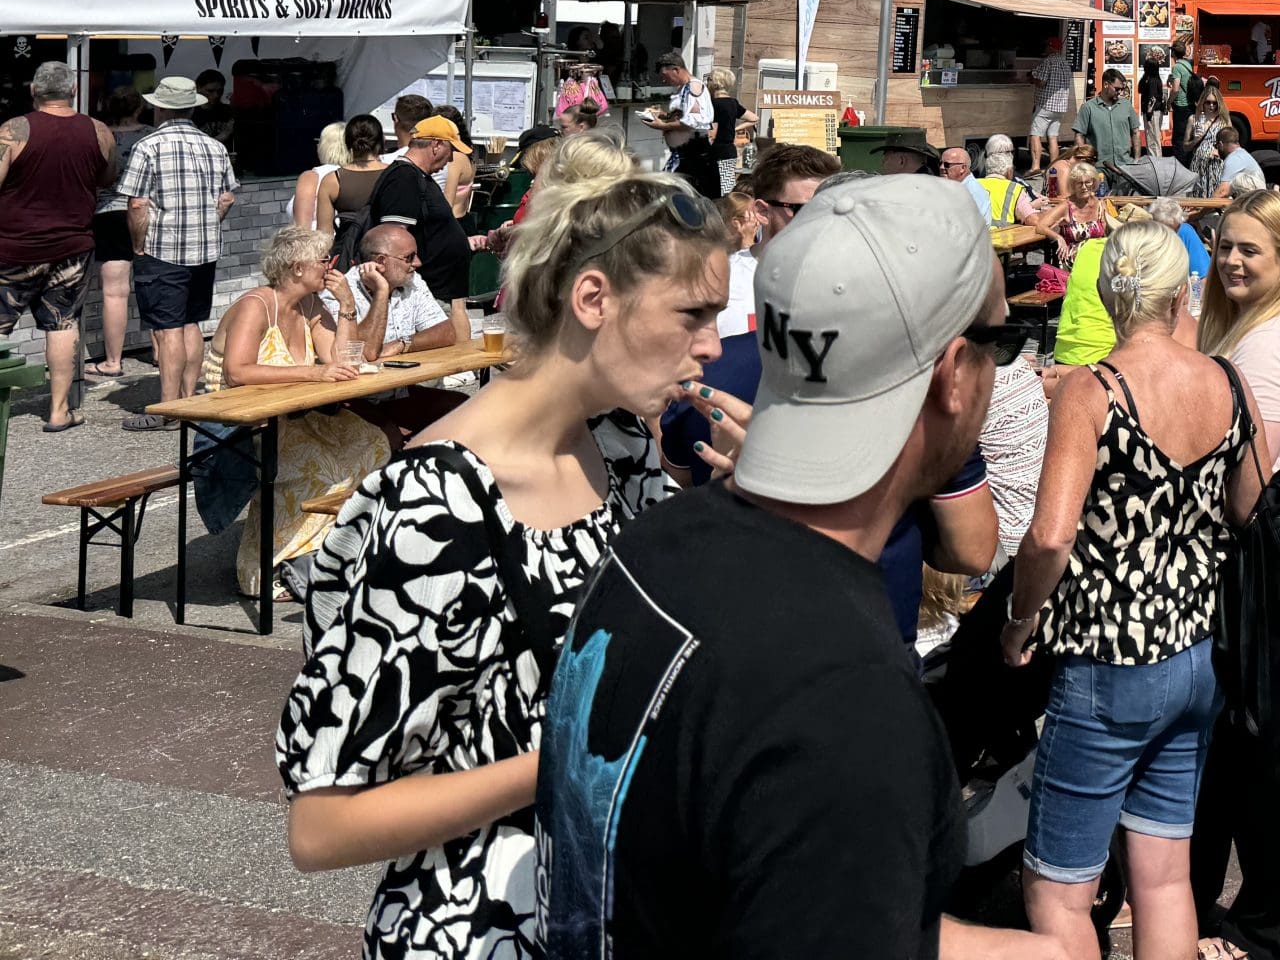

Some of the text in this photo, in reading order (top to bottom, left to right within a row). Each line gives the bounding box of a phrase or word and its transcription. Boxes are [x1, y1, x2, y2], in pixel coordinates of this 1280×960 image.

[763, 94, 834, 106] MILKSHAKES
[762, 302, 840, 382] NY
[650, 639, 700, 720] THE NORTH FACE
